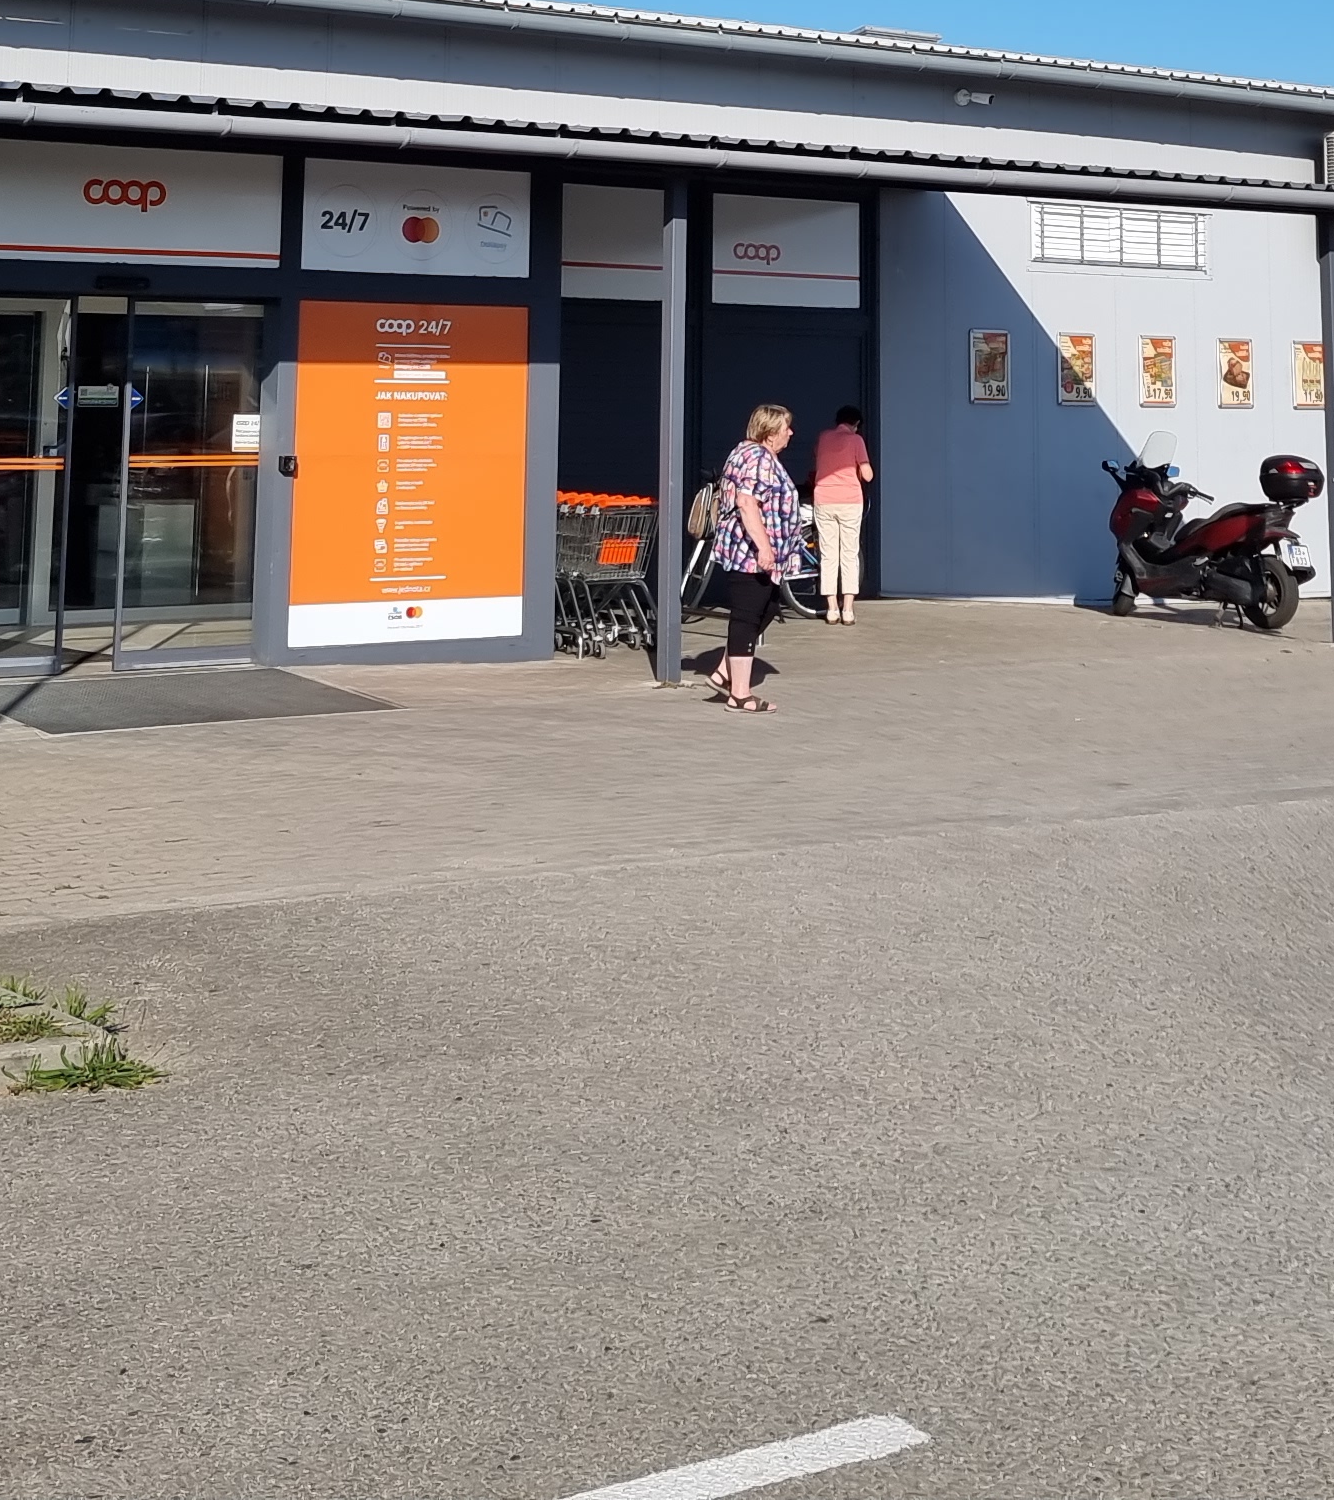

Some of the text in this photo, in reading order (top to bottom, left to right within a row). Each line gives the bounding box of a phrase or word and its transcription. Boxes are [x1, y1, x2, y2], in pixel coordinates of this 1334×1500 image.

[83, 178, 167, 213] coop
[402, 204, 441, 214] Powered by
[320, 208, 370, 234] 24/7
[733, 242, 781, 266] coop
[376, 318, 452, 336] coop 24/7
[375, 390, 392, 400] JAK
[982, 384, 1007, 398] 19,90
[1075, 386, 1093, 400] 9,90
[1152, 388, 1174, 401] 17,90
[1231, 390, 1251, 403] 19,90
